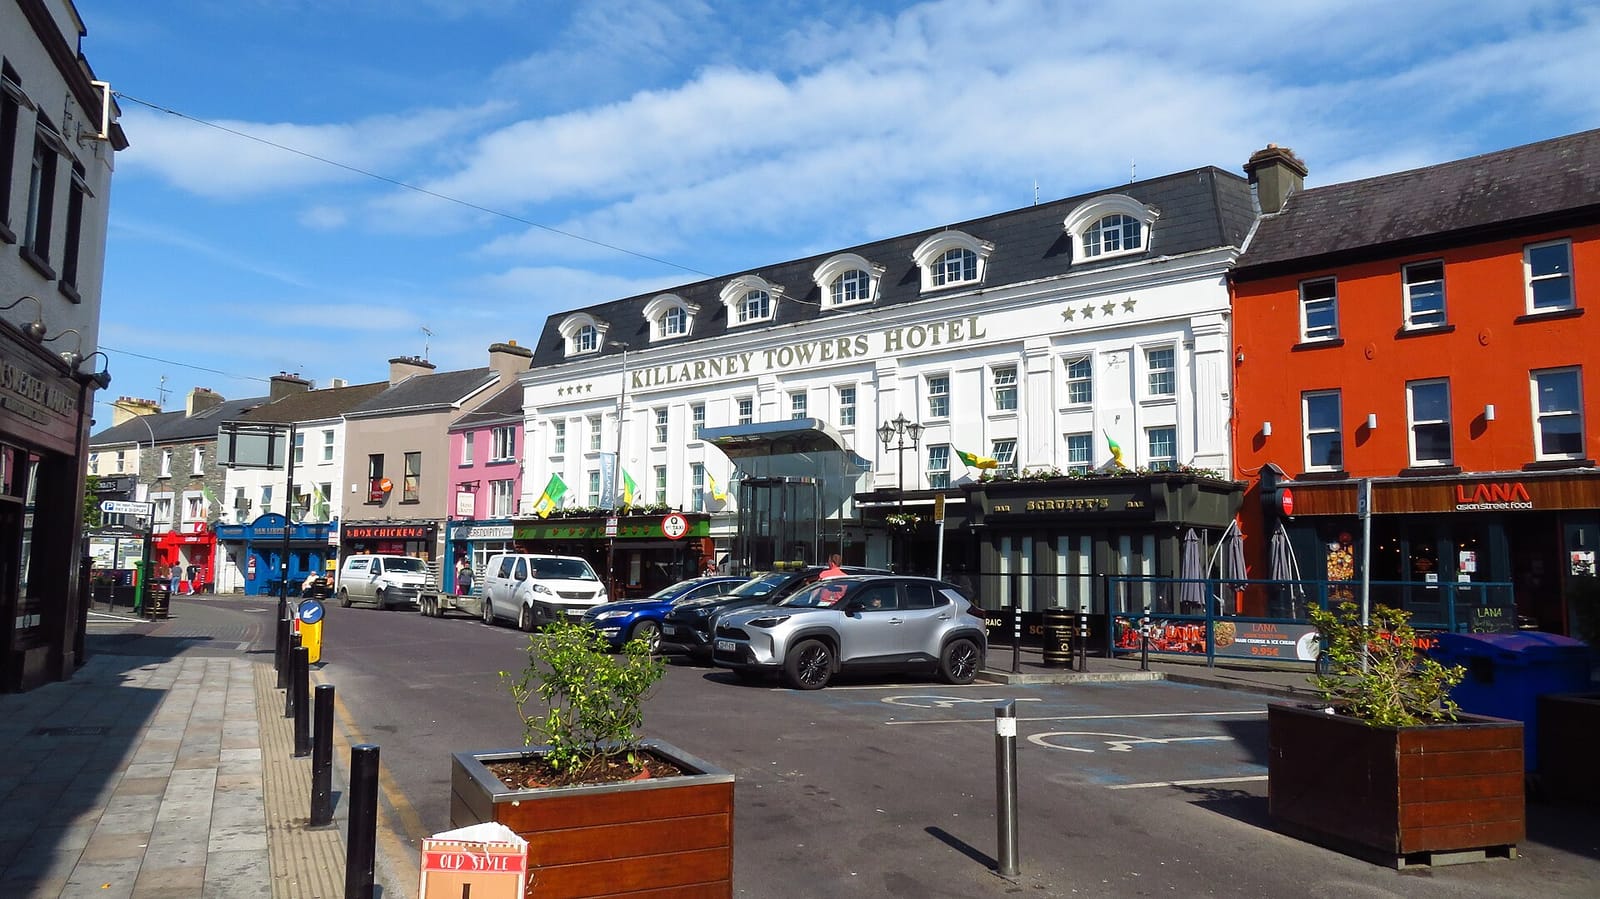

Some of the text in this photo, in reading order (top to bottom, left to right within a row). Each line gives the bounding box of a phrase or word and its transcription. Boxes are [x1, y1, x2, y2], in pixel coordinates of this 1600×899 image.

[631, 316, 987, 389] KILLARNEY TOWERS HOTEL
[1457, 482, 1530, 503] LANA
[1026, 498, 1109, 511] SCRUFFY'S
[1456, 501, 1533, 511] asian street food
[353, 527, 415, 538] BOX CHICKEN
[1477, 607, 1503, 618] LANA
[1252, 623, 1278, 633] LANA
[440, 854, 510, 871] OLD STYLE
